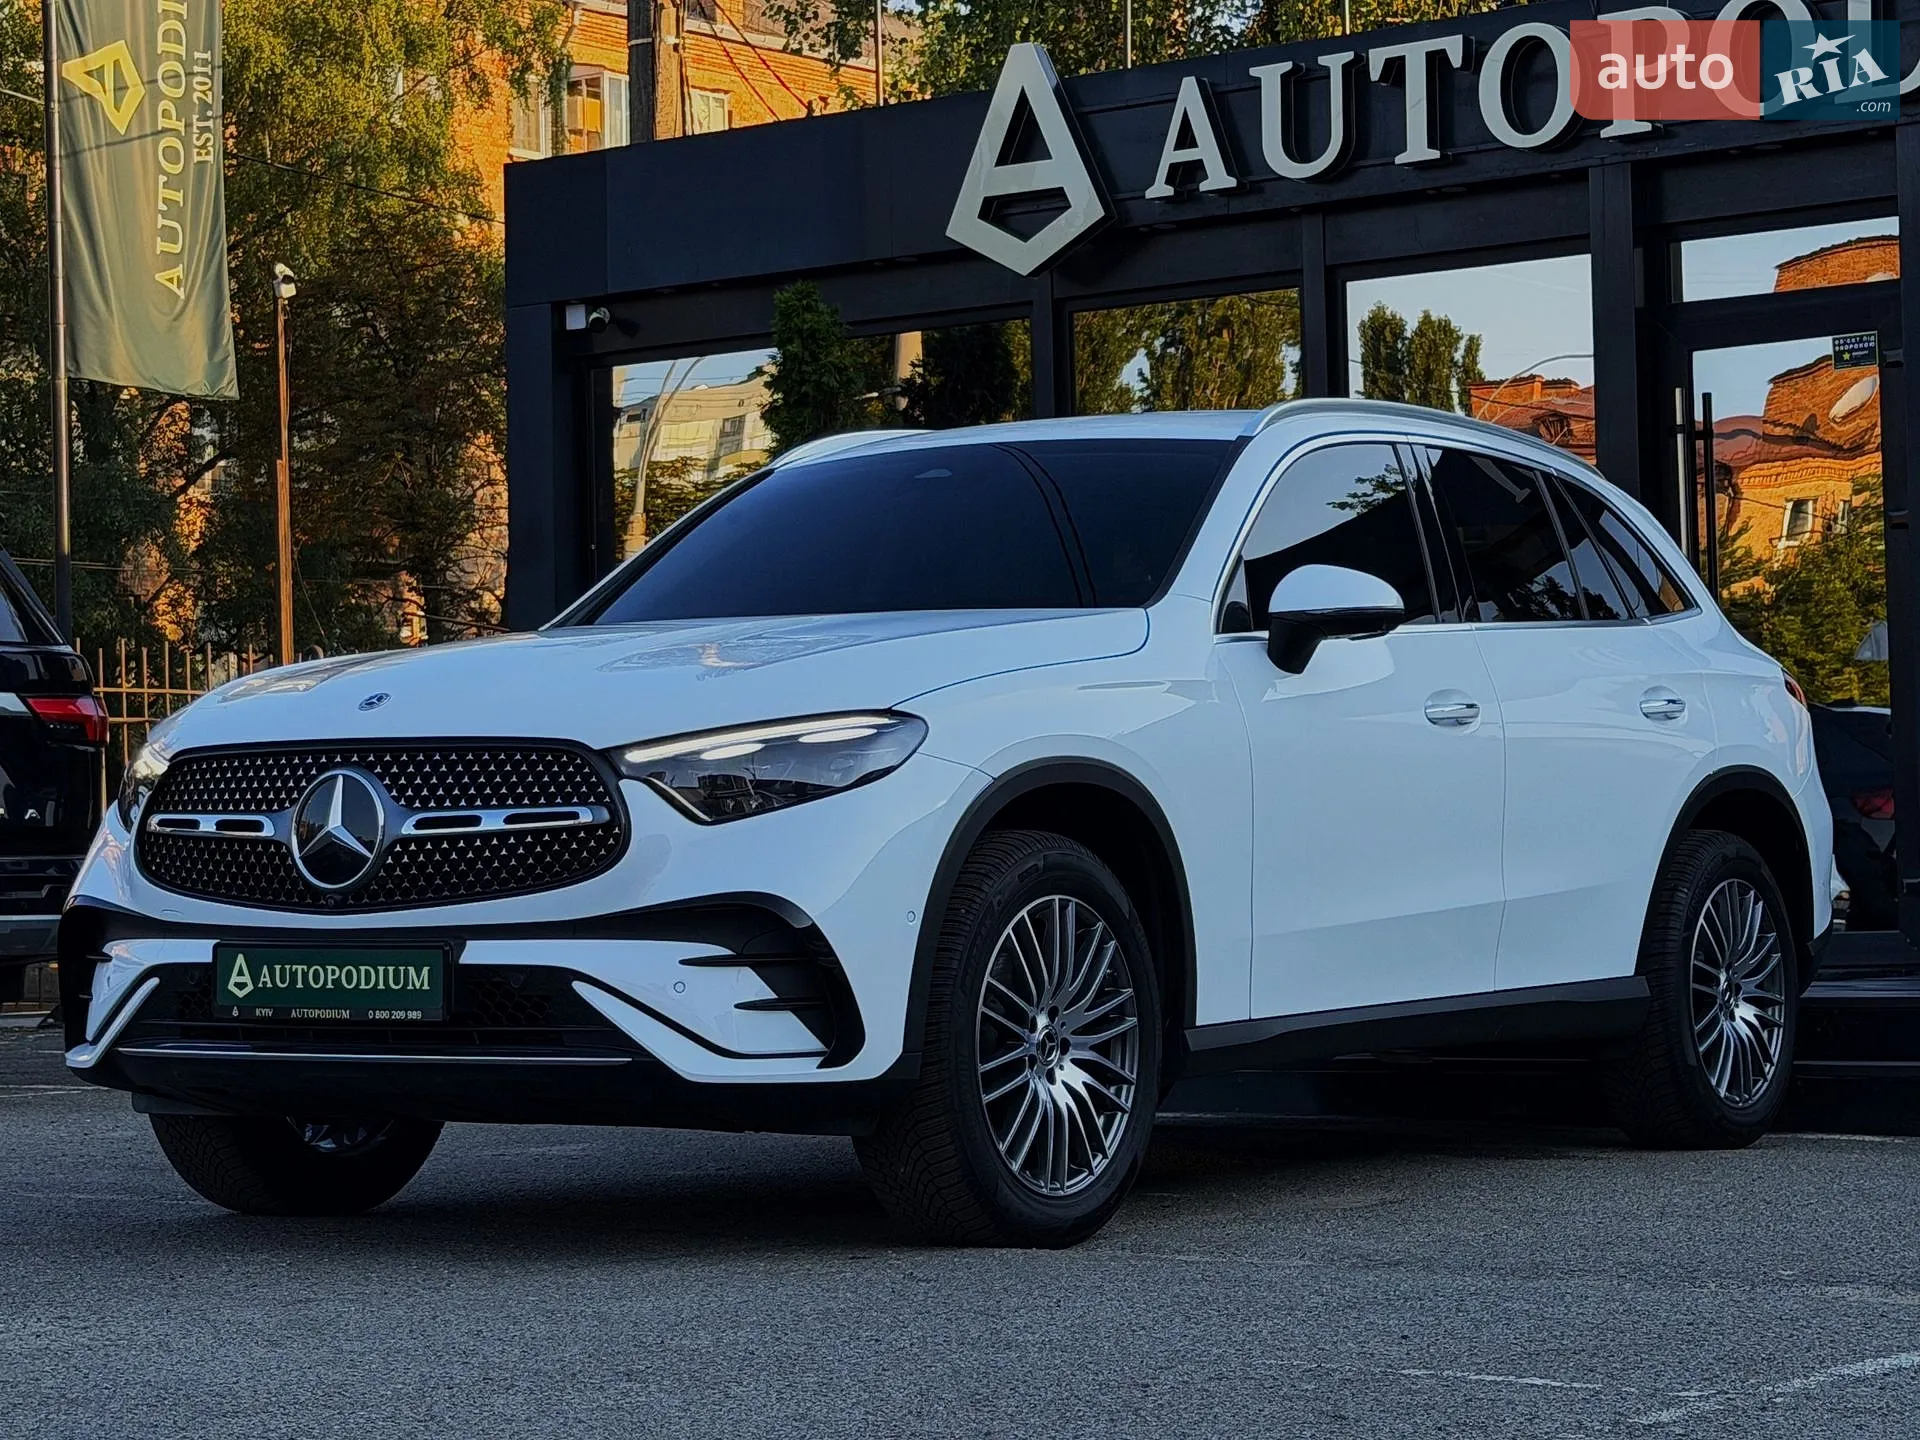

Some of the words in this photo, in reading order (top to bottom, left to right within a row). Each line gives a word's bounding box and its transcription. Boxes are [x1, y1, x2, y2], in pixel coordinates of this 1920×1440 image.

[193, 50, 213, 105] 2011
[193, 110, 214, 164] EST.
[257, 964, 431, 990] AUTOPODIUM
[255, 1008, 274, 1017] KYIV
[290, 1008, 350, 1019] AUTOPODIUM
